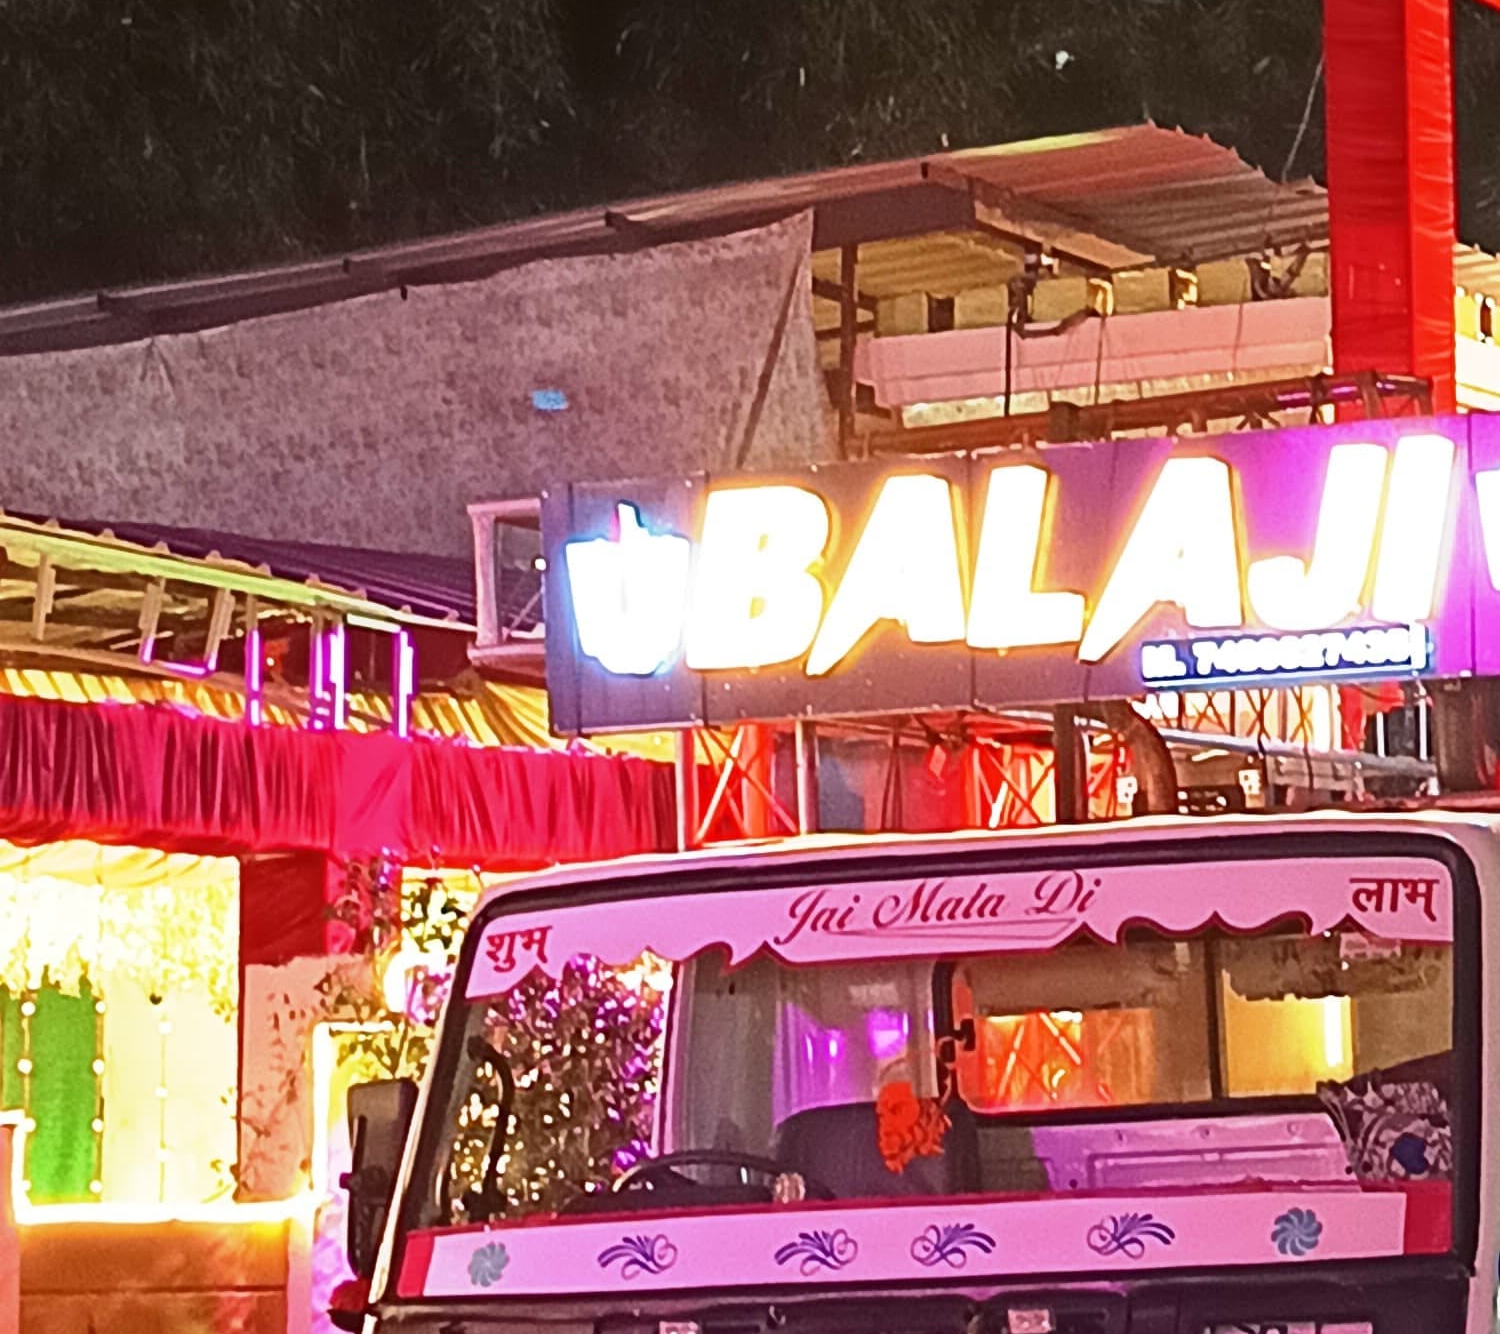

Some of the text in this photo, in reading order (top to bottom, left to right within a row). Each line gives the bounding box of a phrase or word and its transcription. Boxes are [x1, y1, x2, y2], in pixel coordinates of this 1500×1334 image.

[686, 434, 1456, 675] BALAJI
[773, 888, 861, 946] Jai
[1024, 869, 1102, 916] Di
